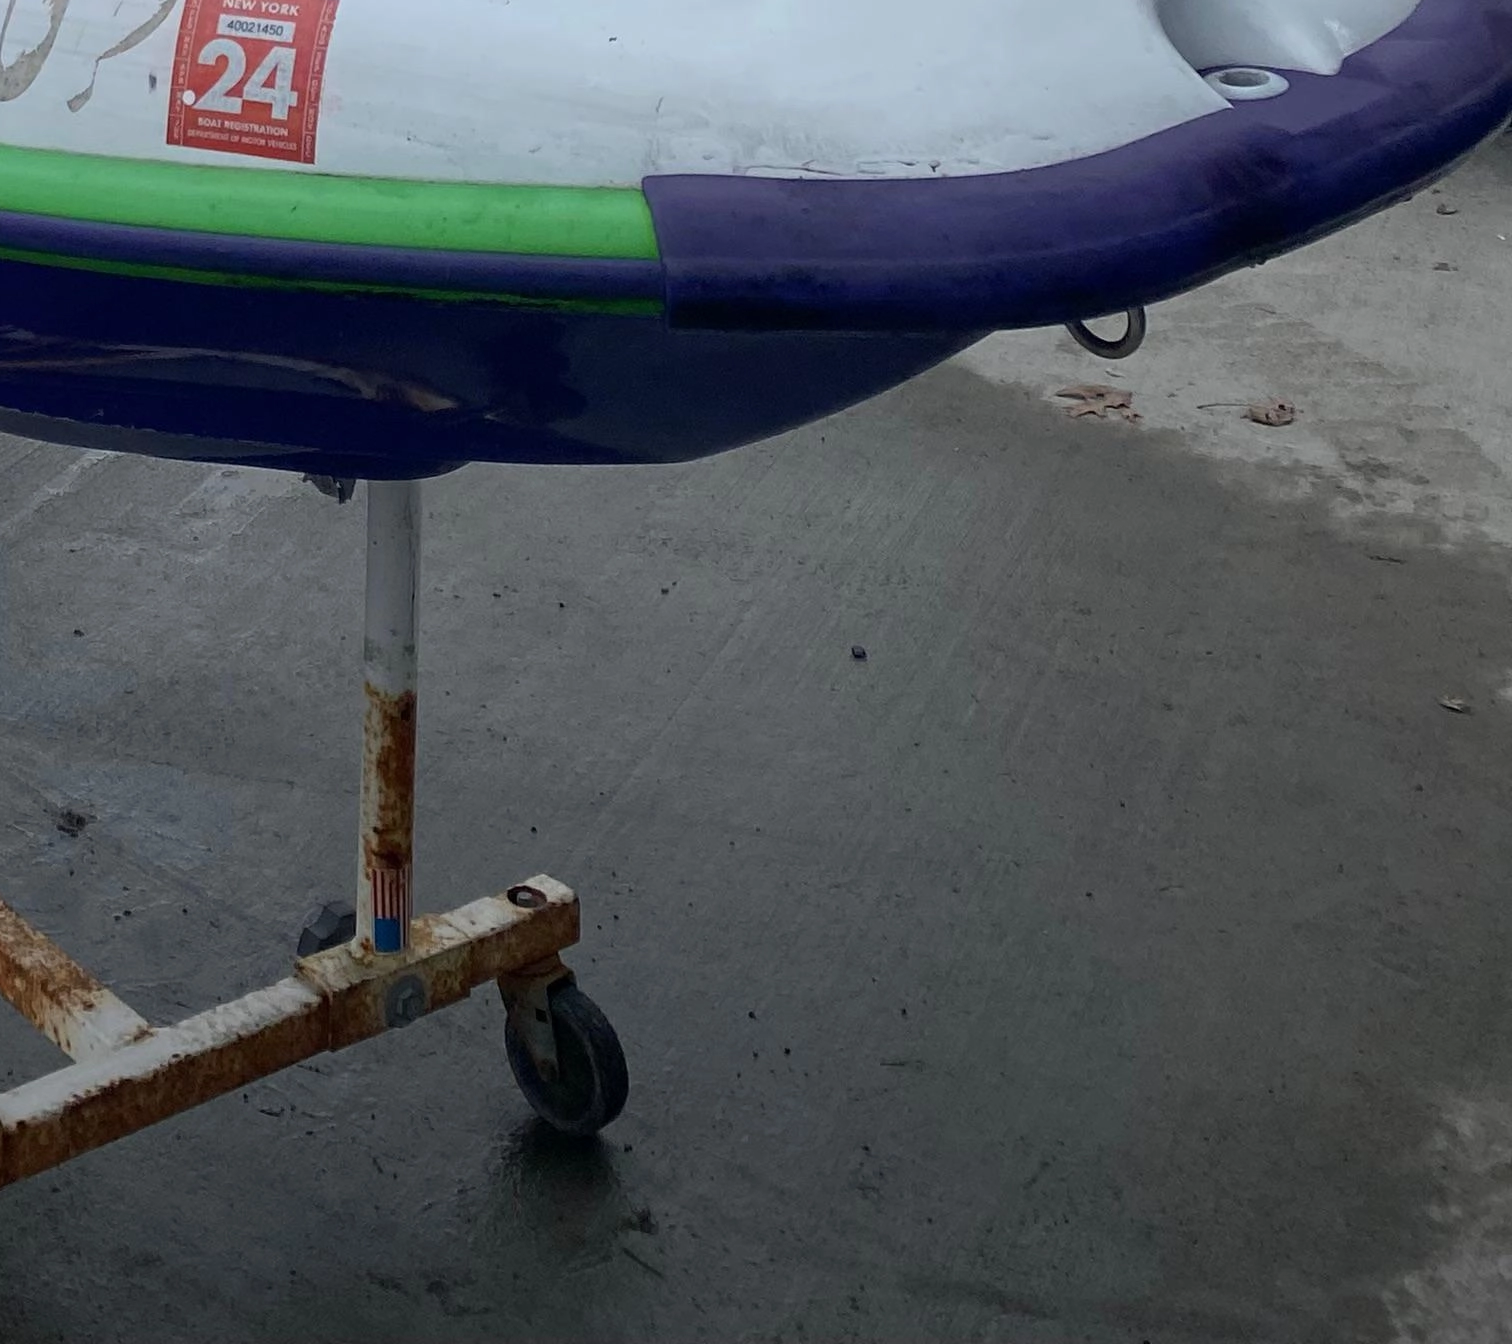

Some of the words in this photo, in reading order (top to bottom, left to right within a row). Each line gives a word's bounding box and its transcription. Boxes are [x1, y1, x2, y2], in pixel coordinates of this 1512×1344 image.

[260, 0, 300, 16] YORK
[227, 20, 284, 36] 40021450
[193, 38, 298, 120] 24
[198, 117, 223, 130] BOAT
[224, 120, 289, 136] REGISTRATION
